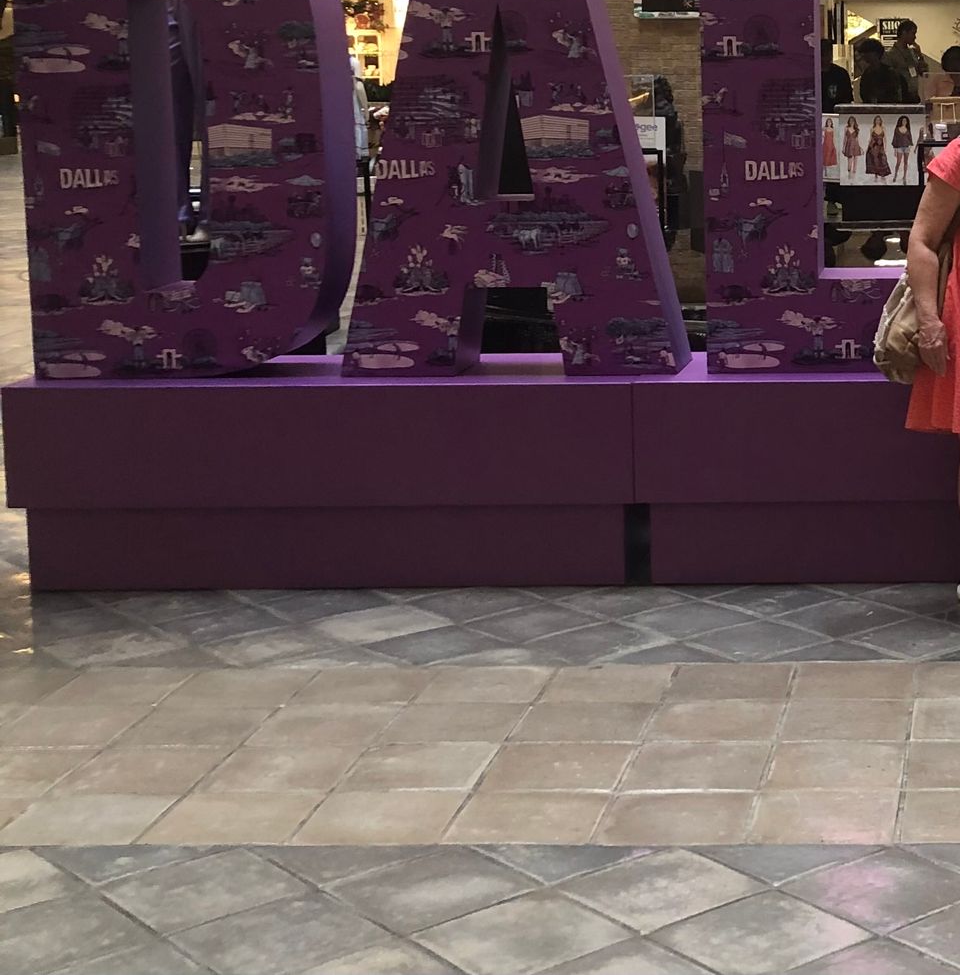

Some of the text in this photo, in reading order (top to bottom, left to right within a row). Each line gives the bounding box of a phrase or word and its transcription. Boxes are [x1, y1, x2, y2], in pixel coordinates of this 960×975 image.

[60, 168, 120, 189] DALLAS
[375, 159, 436, 180] DALLAS
[744, 160, 805, 181] DALLAS
